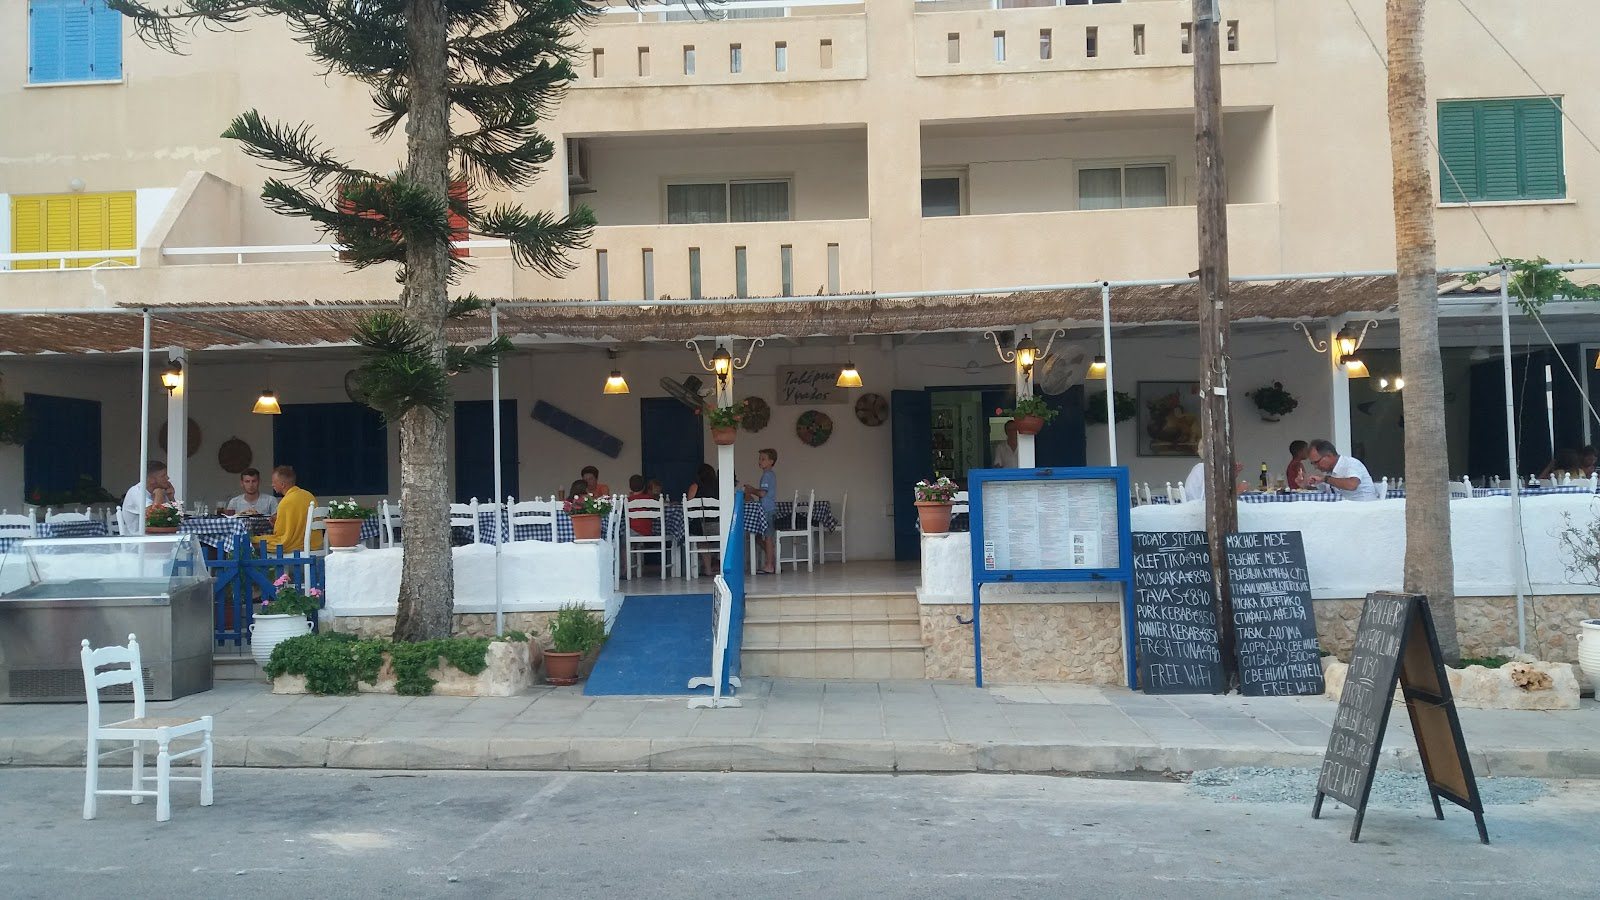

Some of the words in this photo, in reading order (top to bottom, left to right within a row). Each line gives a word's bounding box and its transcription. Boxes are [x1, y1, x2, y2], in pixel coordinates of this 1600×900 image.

[1133, 532, 1168, 546] TODAYS
[1171, 532, 1209, 547] SPECIAL
[1136, 587, 1184, 605] TAVAS
[1136, 603, 1162, 619] PORK
[1150, 663, 1184, 688] FREE
[1262, 682, 1294, 695] FREE
